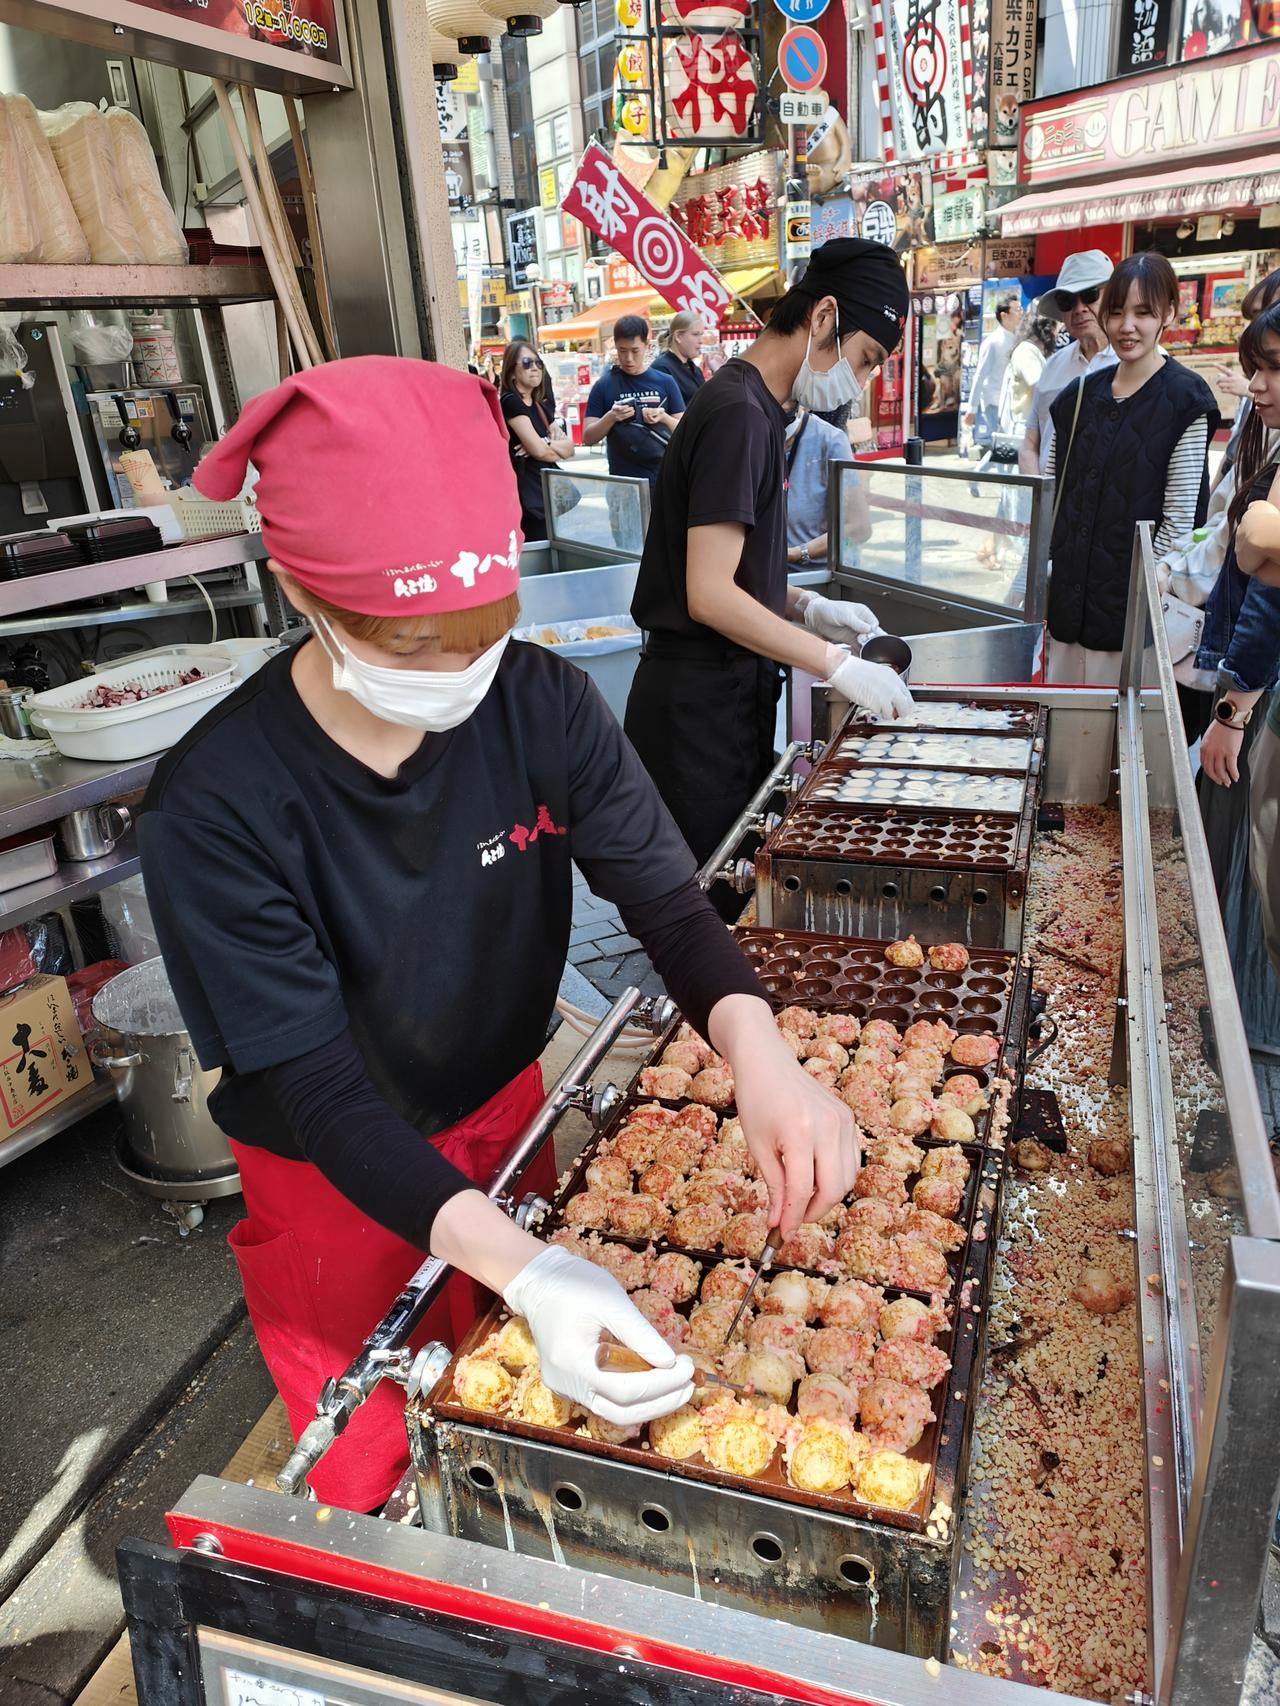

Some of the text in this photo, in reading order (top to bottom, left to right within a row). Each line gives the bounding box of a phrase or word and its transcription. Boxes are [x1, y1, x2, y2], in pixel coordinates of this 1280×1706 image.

[783, 101, 822, 117] 自動車
[1111, 52, 1280, 158] GAME
